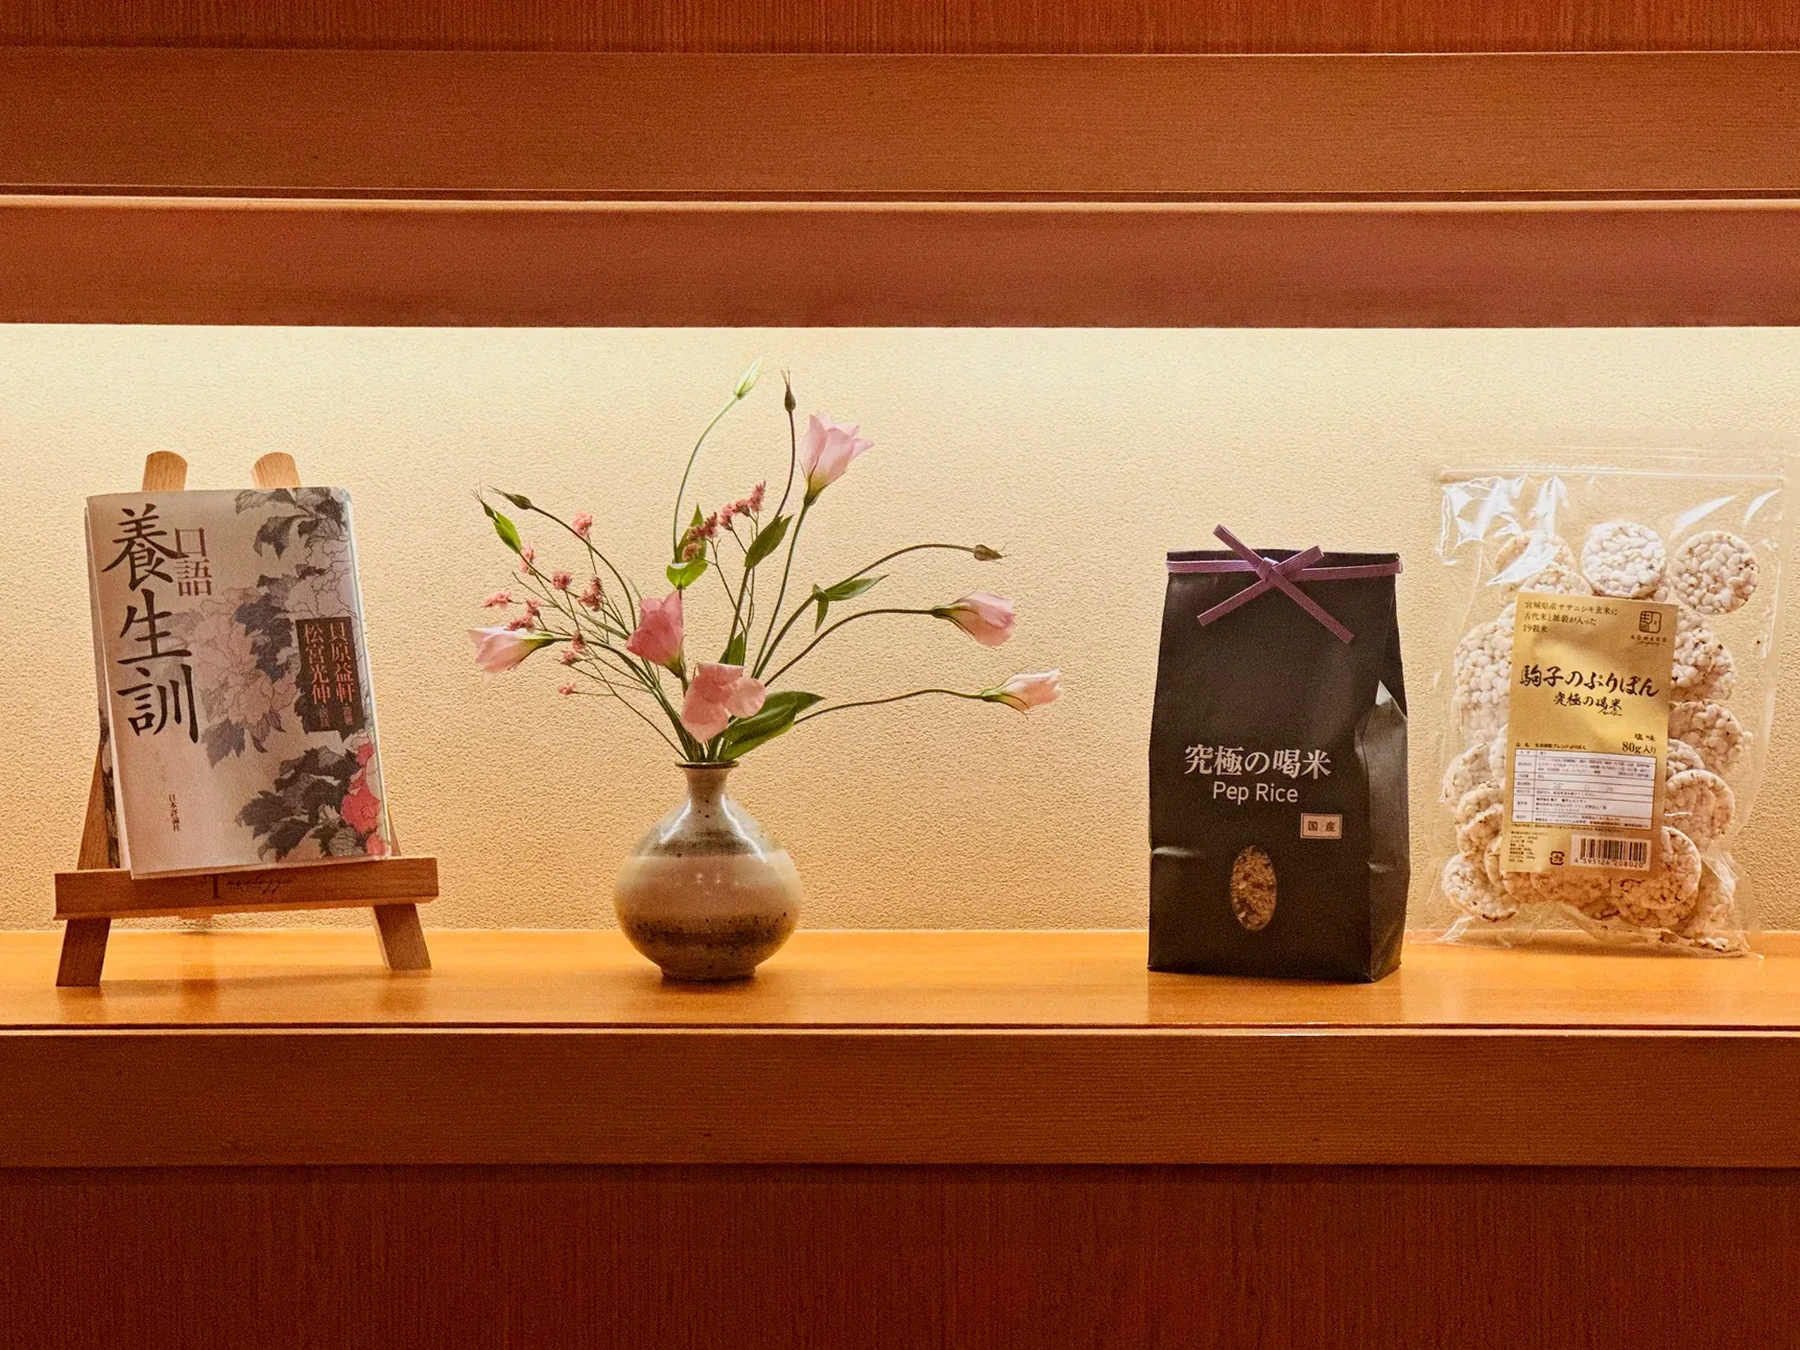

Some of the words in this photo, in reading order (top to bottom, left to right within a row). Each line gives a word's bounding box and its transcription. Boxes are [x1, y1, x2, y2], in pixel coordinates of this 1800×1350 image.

[174, 527, 213, 596] 口語
[102, 503, 199, 743] 養生訓
[1184, 744, 1332, 779] 究極の喝米
[1212, 781, 1249, 805] Pep
[1255, 783, 1299, 803] Rice
[1307, 820, 1337, 832] 国産
